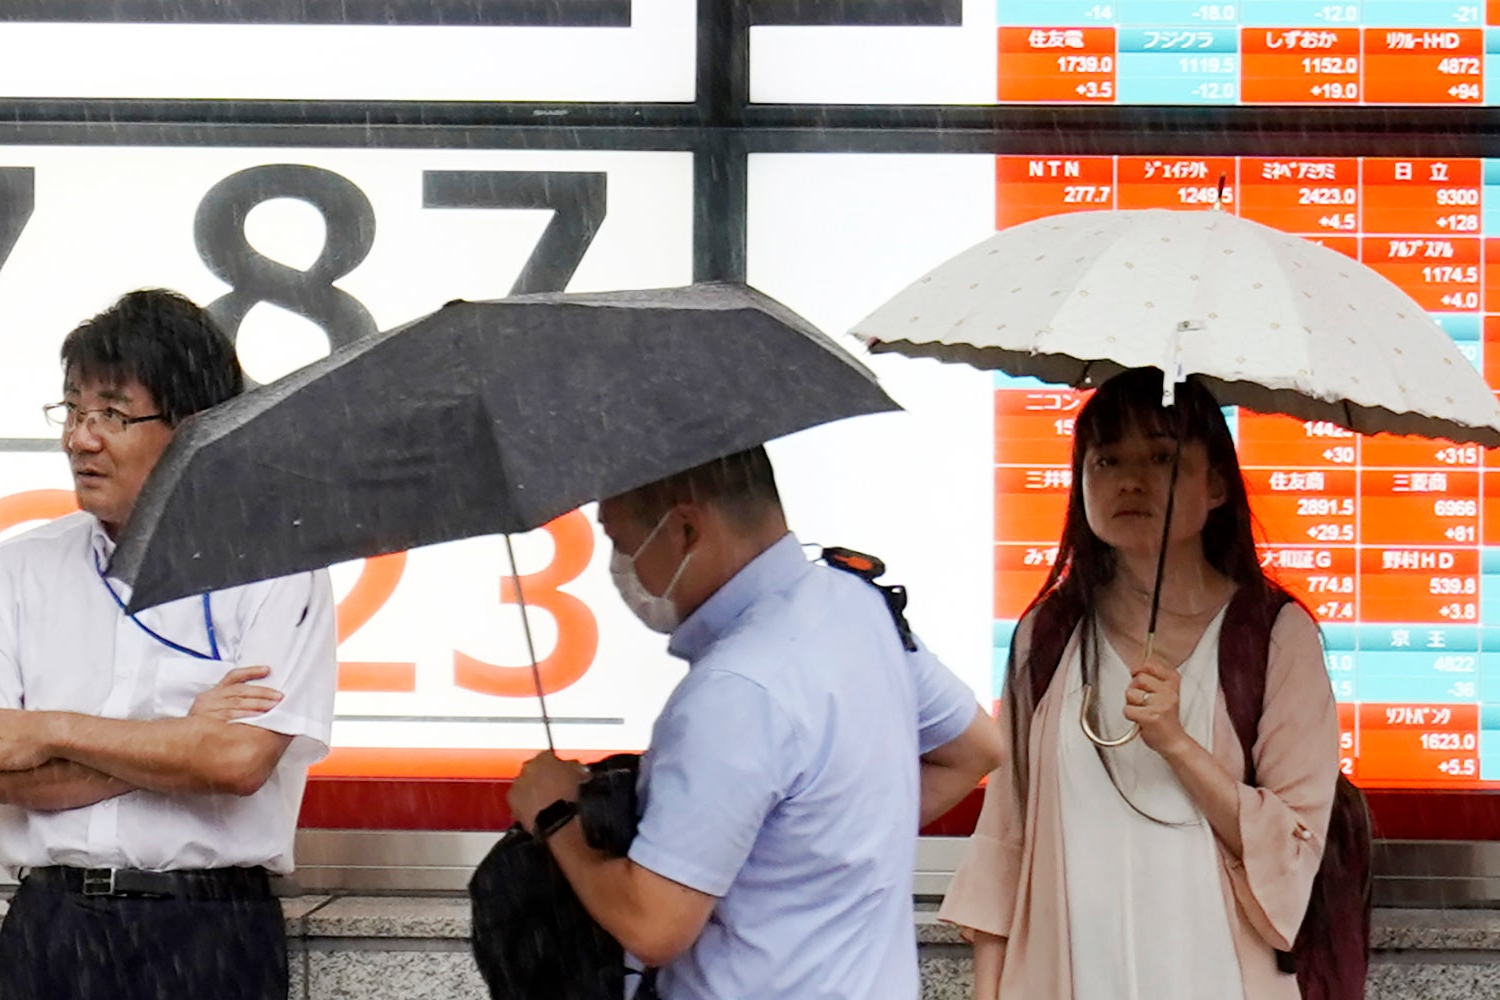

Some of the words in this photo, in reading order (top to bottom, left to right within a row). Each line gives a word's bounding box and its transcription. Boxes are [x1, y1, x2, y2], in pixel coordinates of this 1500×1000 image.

[1143, 32, 1214, 48] フジクラ
[1267, 30, 1337, 48] しずおか
[1058, 56, 1113, 72] 1739.0
[1303, 58, 1358, 73] 1152.0
[1438, 58, 1480, 74] 4872
[1076, 82, 1112, 97] +3.5
[1311, 83, 1357, 98] +19.0
[1449, 84, 1479, 99] +94
[1065, 186, 1110, 202] 277.7
[1178, 187, 1233, 203] 12495
[1300, 188, 1356, 204] 2423.0
[1437, 189, 1479, 204] 9300
[1319, 214, 1356, 229] +4.5
[1437, 215, 1478, 231] +128
[1423, 267, 1478, 282] 1174.5
[1442, 293, 1478, 308] +4.0
[1026, 394, 1080, 410] ニコン
[1323, 447, 1354, 462] +30
[1436, 448, 1477, 463] +315
[1298, 498, 1354, 515] 2891.5
[1435, 500, 1476, 516] 6966
[1308, 524, 1354, 540] +29.5
[1445, 526, 1474, 541] +81
[1308, 576, 1353, 593] 774.8
[1430, 578, 1476, 594] 539.8
[1317, 602, 1353, 618] +7.4
[1440, 604, 1476, 620] +3.8
[1421, 733, 1475, 749] 1623.0
[1439, 759, 1476, 775] +5.5
